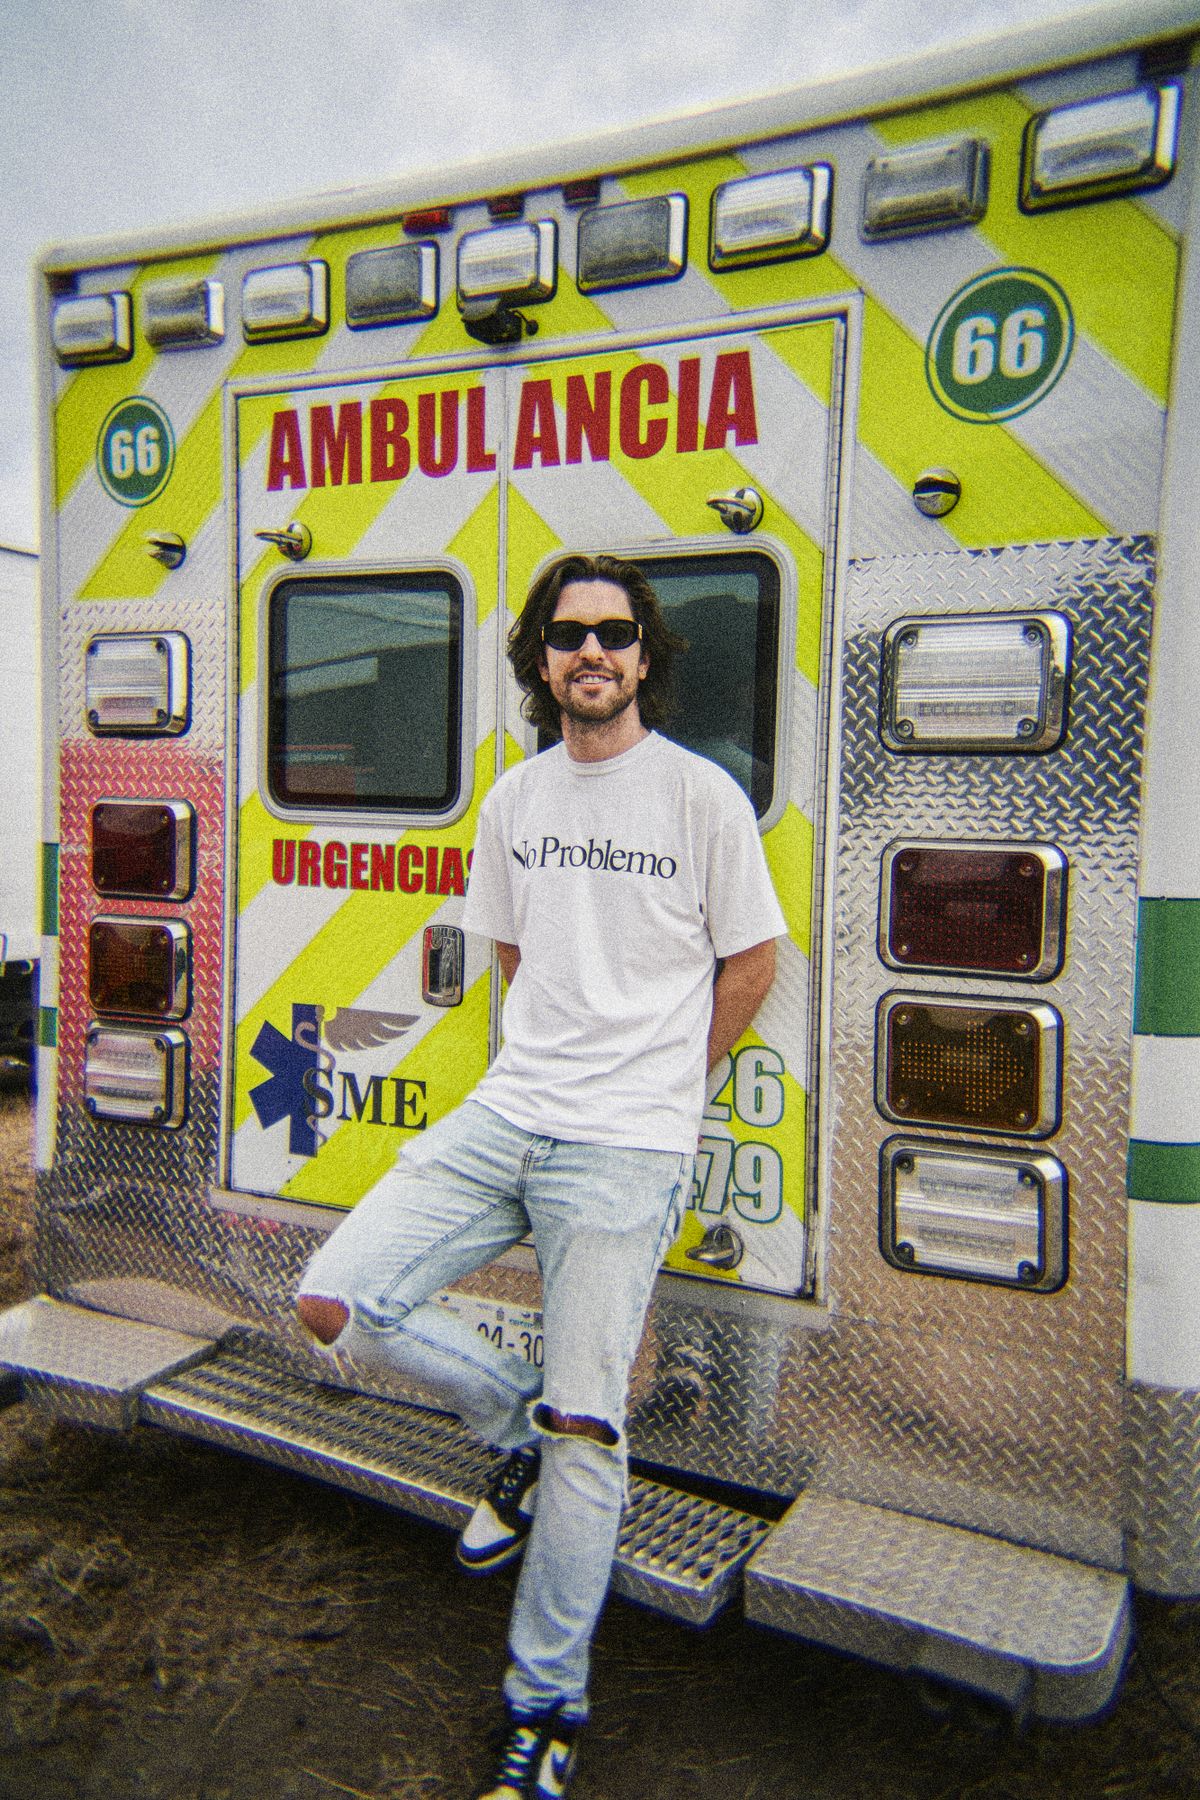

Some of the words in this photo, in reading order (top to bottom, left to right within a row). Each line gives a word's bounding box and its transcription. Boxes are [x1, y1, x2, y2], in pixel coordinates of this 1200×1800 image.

[953, 306, 1047, 385] 66
[110, 425, 161, 480] 66
[272, 838, 475, 898] URGENCIA
[511, 840, 537, 870] No
[538, 836, 677, 879] Problemo
[303, 1067, 428, 1131] SME
[686, 1134, 784, 1224] 79
